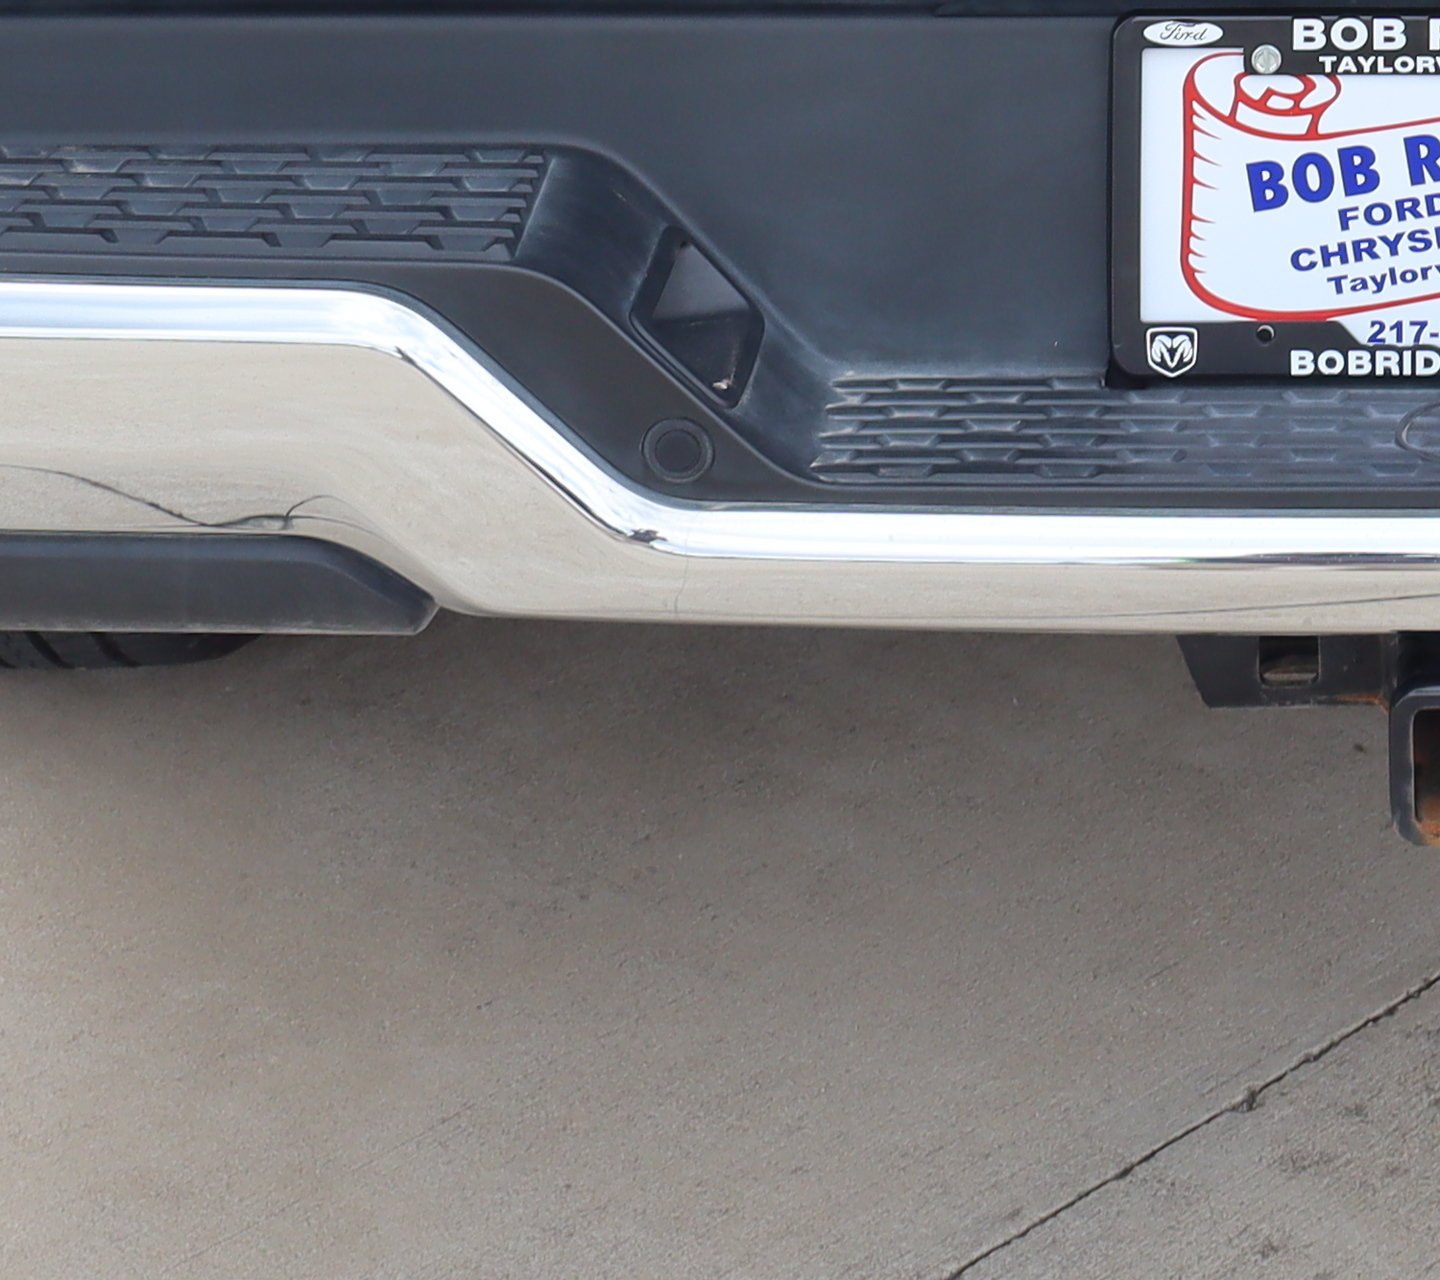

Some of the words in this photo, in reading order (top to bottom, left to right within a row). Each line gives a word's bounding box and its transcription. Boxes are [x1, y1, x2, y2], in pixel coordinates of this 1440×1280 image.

[1160, 20, 1209, 42] Ford
[1291, 17, 1407, 52] BOB
[1245, 144, 1381, 213] BOB
